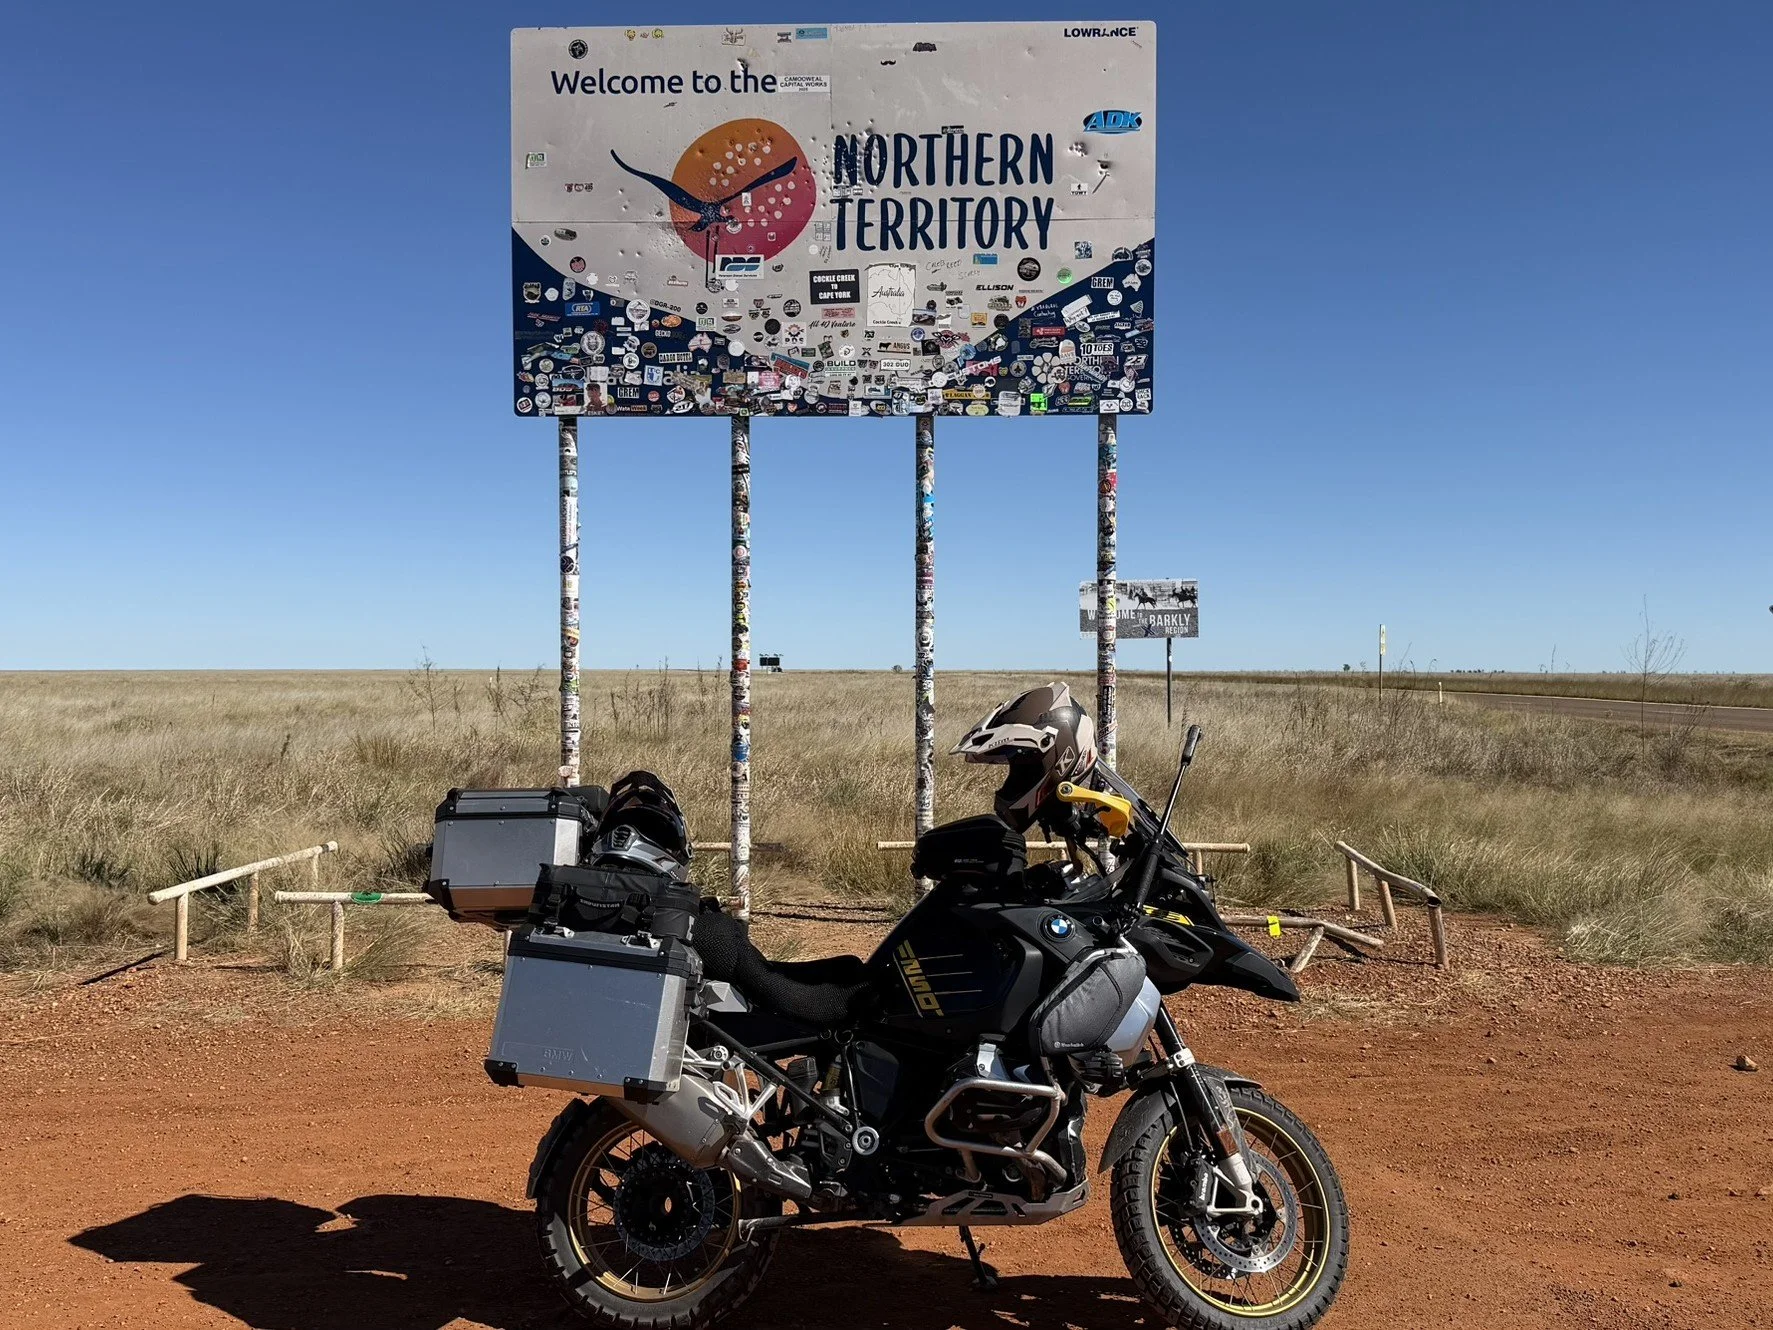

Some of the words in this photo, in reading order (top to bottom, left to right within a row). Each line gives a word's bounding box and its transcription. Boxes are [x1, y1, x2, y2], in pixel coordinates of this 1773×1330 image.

[1064, 27, 1137, 37] LOWRANCE
[551, 68, 683, 94] Welcome
[692, 70, 721, 93] to
[730, 67, 777, 93] the
[1083, 110, 1142, 132] ADK
[833, 133, 1053, 188] NORTHERN
[830, 196, 1055, 250] TERRITORY
[813, 275, 836, 283] COCKLE
[836, 274, 856, 282] CREEK
[1092, 277, 1114, 288] GREM
[818, 291, 834, 299] CAPE
[835, 291, 851, 299] YORK
[871, 286, 905, 298] Australia
[893, 342, 911, 350] ANGUS
[1081, 343, 1093, 355] 10
[618, 388, 639, 398] GREM
[1149, 613, 1191, 626] BARKLY
[1165, 626, 1189, 634] REGION
[543, 1048, 574, 1061] BMW
